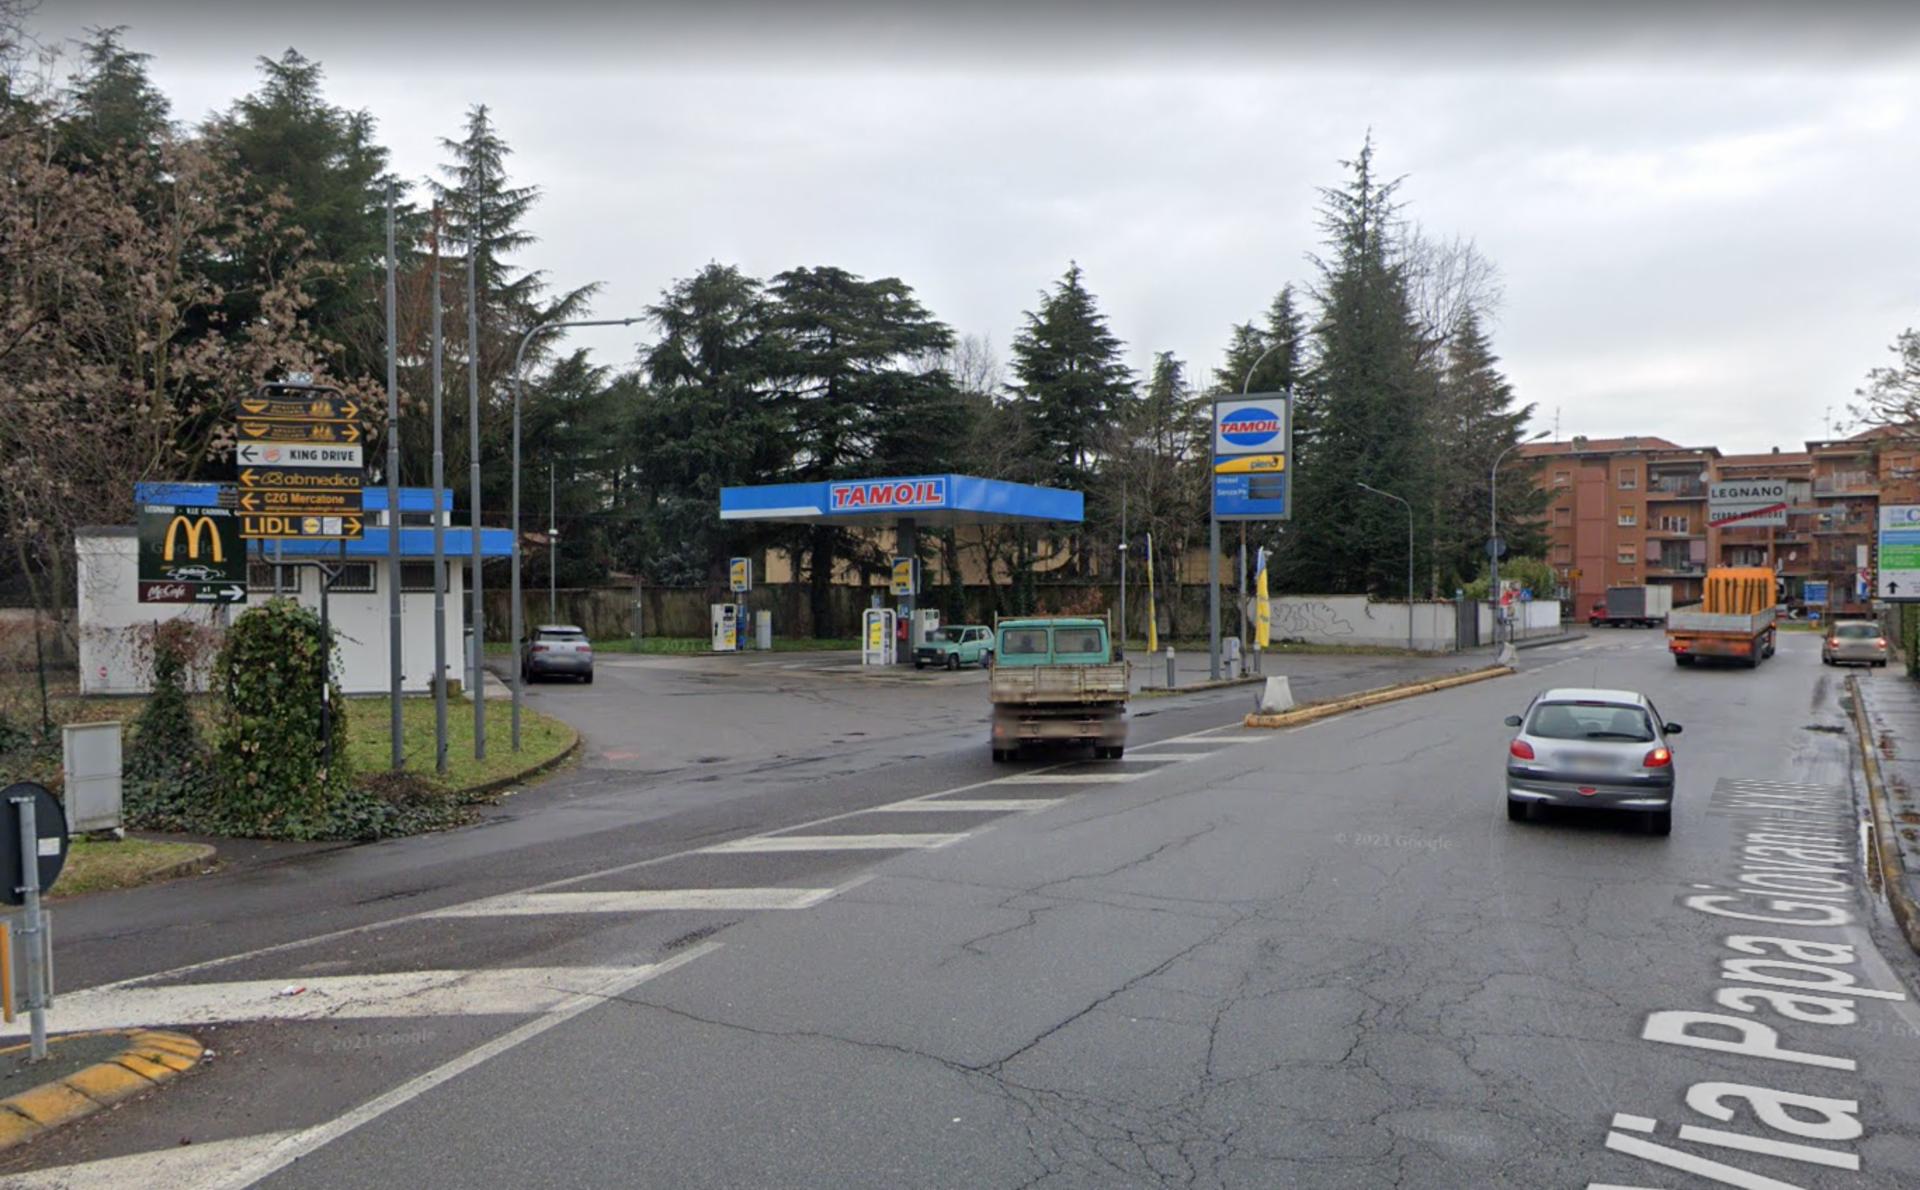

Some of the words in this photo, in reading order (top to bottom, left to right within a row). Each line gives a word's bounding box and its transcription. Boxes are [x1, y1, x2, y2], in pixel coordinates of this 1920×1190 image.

[1220, 421, 1280, 433] TAMOIL
[289, 449, 318, 461] KING
[321, 450, 354, 461] DRIVE
[284, 473, 359, 486] abmedica
[834, 482, 942, 506] TAMOIL
[1711, 486, 1783, 498] LEGNANO
[264, 493, 289, 504] CZG
[291, 493, 345, 504] Mercatone
[245, 517, 298, 534] LIDL
